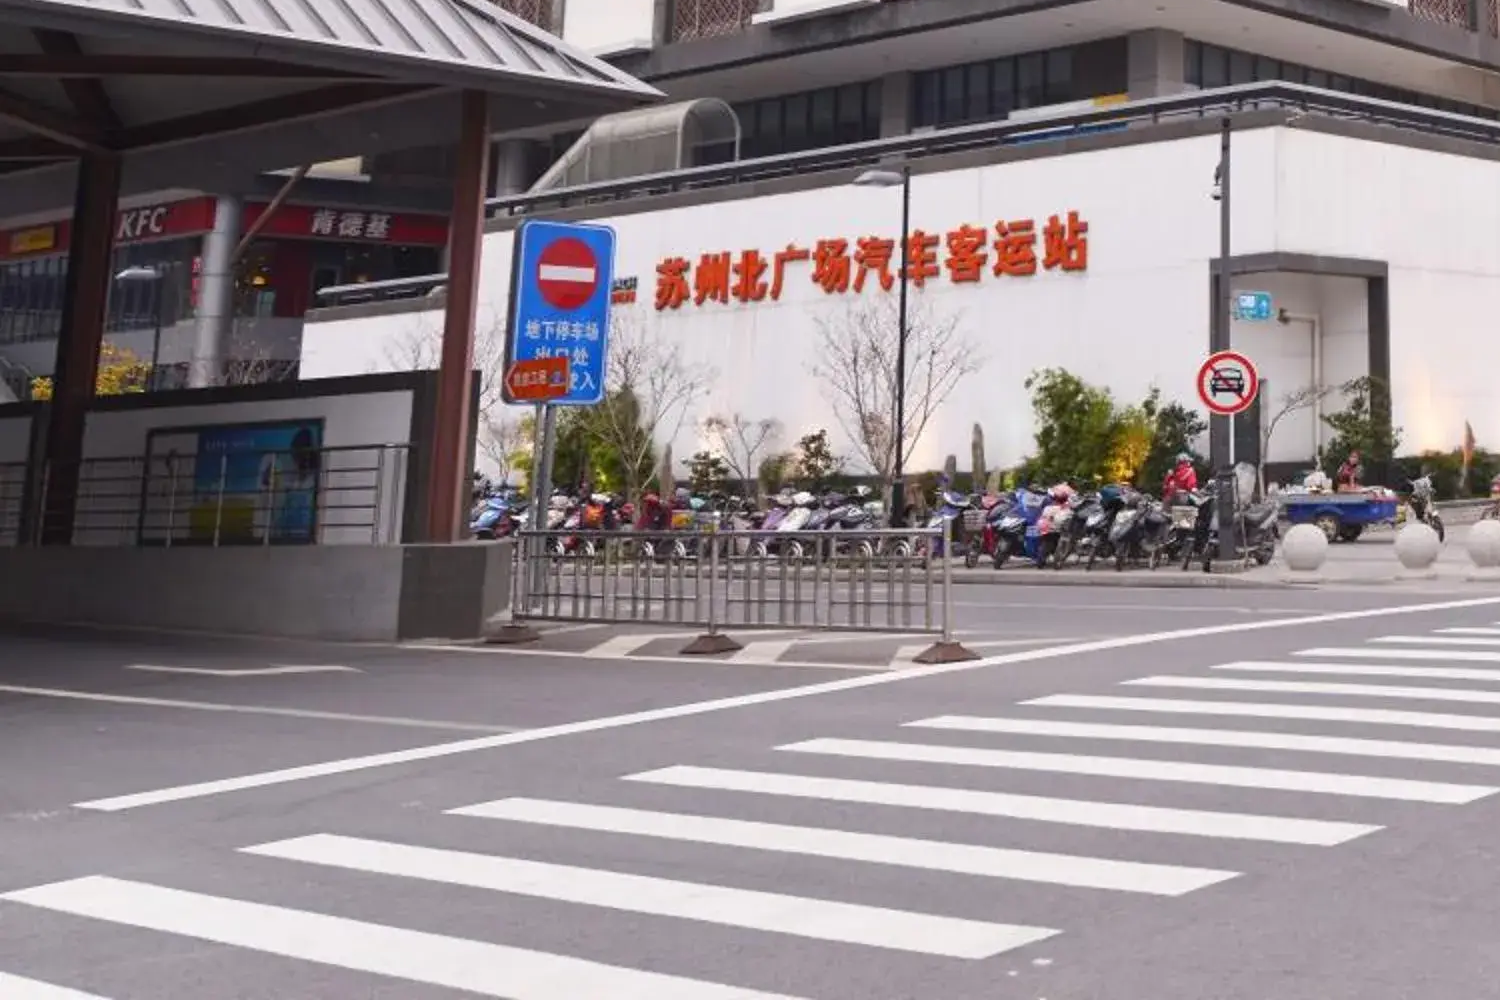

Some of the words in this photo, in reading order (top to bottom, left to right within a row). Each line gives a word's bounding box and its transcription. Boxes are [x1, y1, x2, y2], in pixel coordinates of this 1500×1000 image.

[116, 207, 168, 239] KFC
[310, 208, 392, 239] 肯德基
[654, 211, 1089, 310] 苏州北广场汽车客运站
[525, 319, 600, 341] 地下停车场
